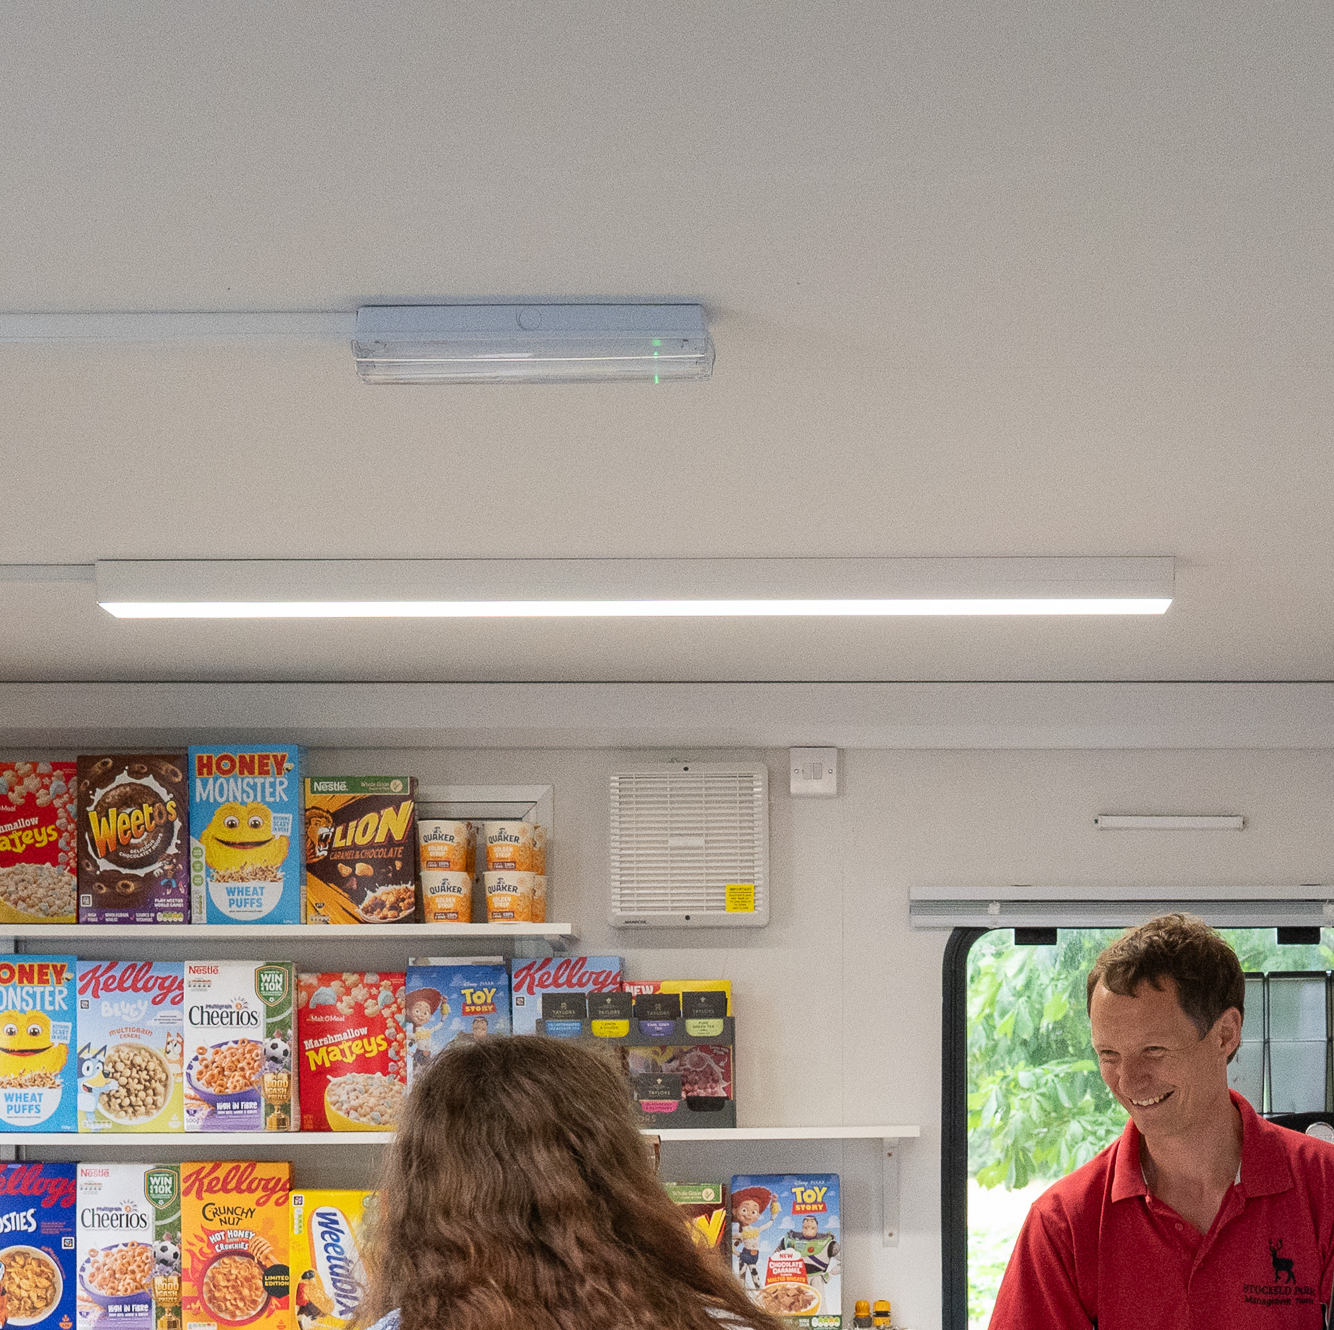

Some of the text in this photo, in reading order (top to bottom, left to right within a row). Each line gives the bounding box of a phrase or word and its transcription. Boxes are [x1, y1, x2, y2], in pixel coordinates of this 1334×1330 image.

[196, 752, 289, 778] HONEY
[195, 777, 289, 803] MONSTER
[88, 800, 177, 859] Weetos
[423, 833, 455, 844] QUAKER
[488, 833, 520, 844] QUAKER
[330, 849, 355, 860] CARAMEL
[361, 846, 404, 860] CHOCOLATE
[226, 886, 265, 897] WHEAT
[429, 884, 462, 895] QUAKER
[487, 884, 518, 894] QUAKER
[228, 897, 263, 909] PUFFS
[188, 965, 219, 975] Nestlé
[260, 973, 283, 983] WIN
[625, 985, 653, 995] NEW
[461, 987, 497, 1005] TOY
[464, 1004, 494, 1013] STORY
[188, 1005, 259, 1026] Cheerios
[303, 1026, 368, 1050] Marshmallow
[305, 1034, 388, 1071] Mateys
[4, 1092, 44, 1103] WHEAT
[6, 1104, 41, 1114] PUFFS
[217, 1101, 258, 1110] HIGH IN FIBRE
[80, 1168, 109, 1177] Nestlé
[150, 1176, 172, 1186] WIN
[791, 1186, 828, 1204] TOY
[201, 1202, 256, 1220] CRUNCHY
[795, 1203, 825, 1212] STORY
[81, 1207, 148, 1229] Cheerios
[219, 1216, 242, 1226] NUT
[209, 1229, 255, 1244] HOT HONEY
[215, 1242, 249, 1252] CRUNCHIES
[315, 1211, 357, 1317] Weetabix
[769, 1261, 803, 1269] CHOCOLATE
[772, 1267, 802, 1275] CARAMEL
[1243, 1284, 1292, 1295] STOCKELD
[1245, 1296, 1314, 1306] Management Team
[108, 1304, 149, 1313] HIGH IN FIBRE
